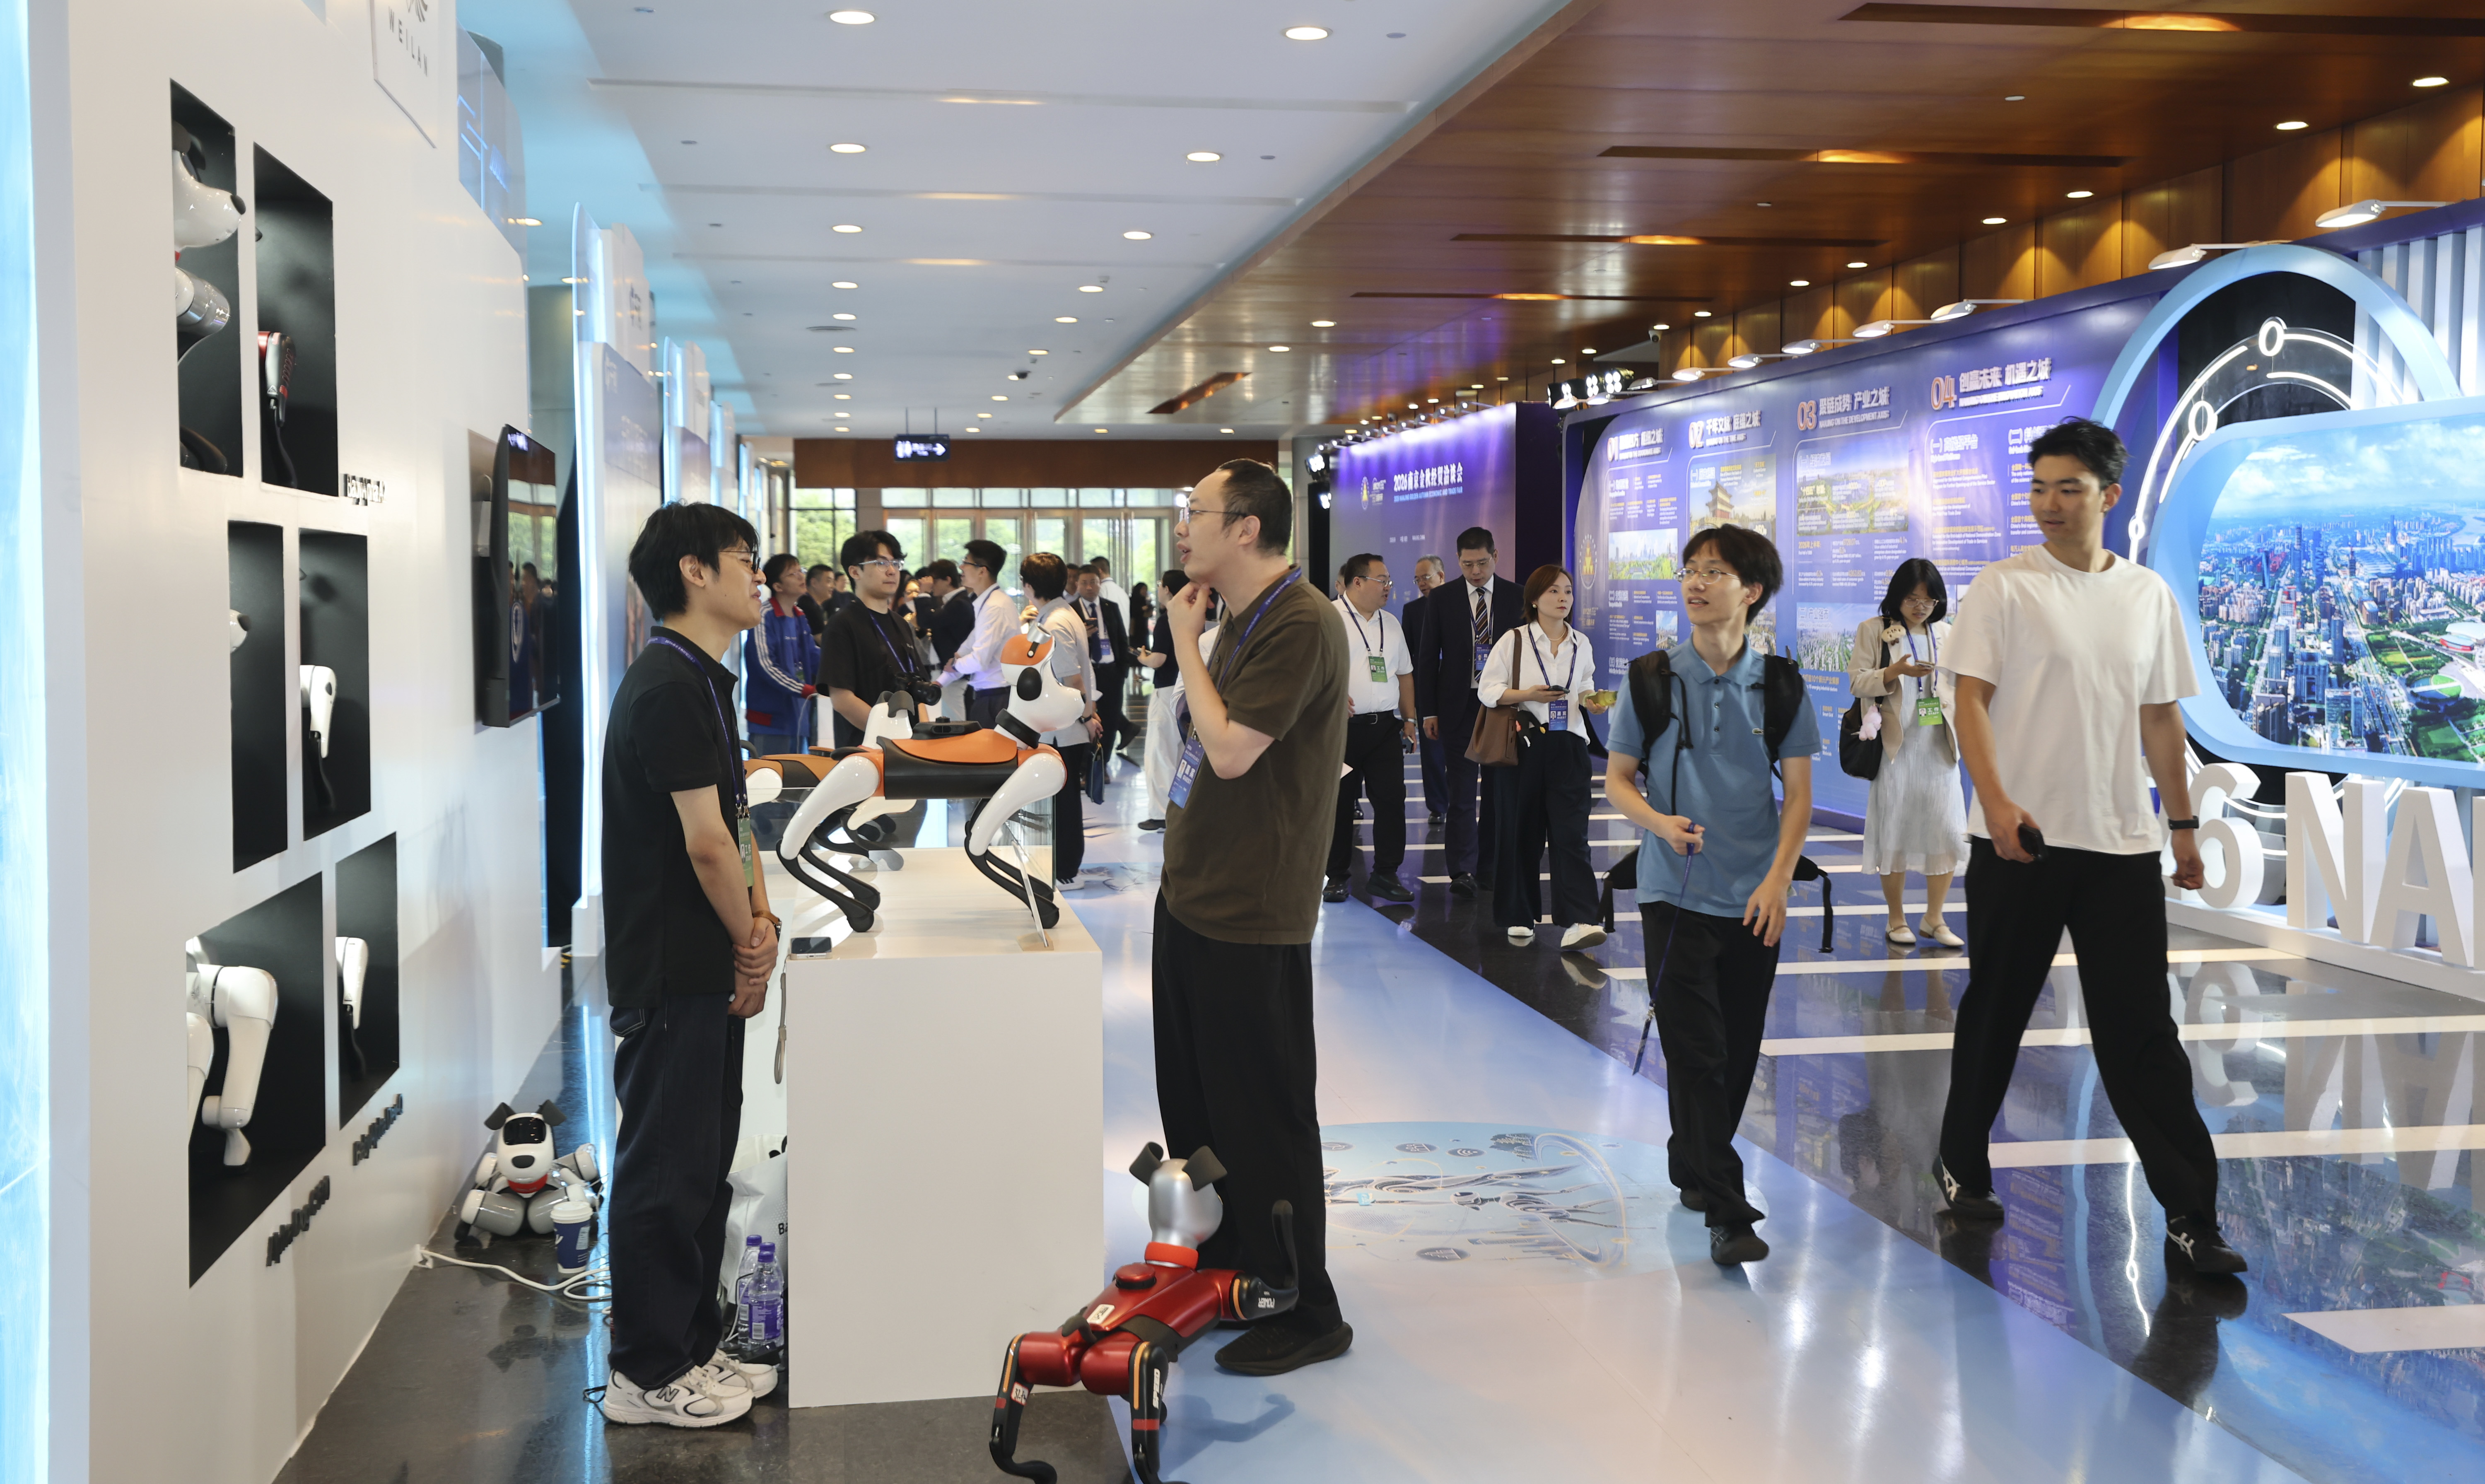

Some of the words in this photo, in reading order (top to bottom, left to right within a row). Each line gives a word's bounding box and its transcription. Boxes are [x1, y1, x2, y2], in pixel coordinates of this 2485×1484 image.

[388, 6, 428, 77] WEILAN
[1959, 366, 2002, 393] 创赢未来
[2004, 357, 2051, 386] 机遇之城
[1819, 393, 1853, 416] 聚链成势
[1853, 386, 1890, 410] 产业之城
[1931, 375, 1957, 410] 04
[1797, 400, 1817, 431] 03
[1819, 418, 1835, 429] NANJING
[1835, 417, 1841, 425] ON
[1841, 416, 1849, 425] THE
[1849, 412, 1877, 425] DEVELOPMENT
[1607, 436, 1619, 462] 01
[1688, 420, 1704, 449] 02
[1393, 461, 1463, 492] 2026南京金秋经贸洽谈会
[2285, 771, 2485, 970] NA
[1258, 1297, 1275, 1309] POWER
[656, 1385, 680, 1403] N
